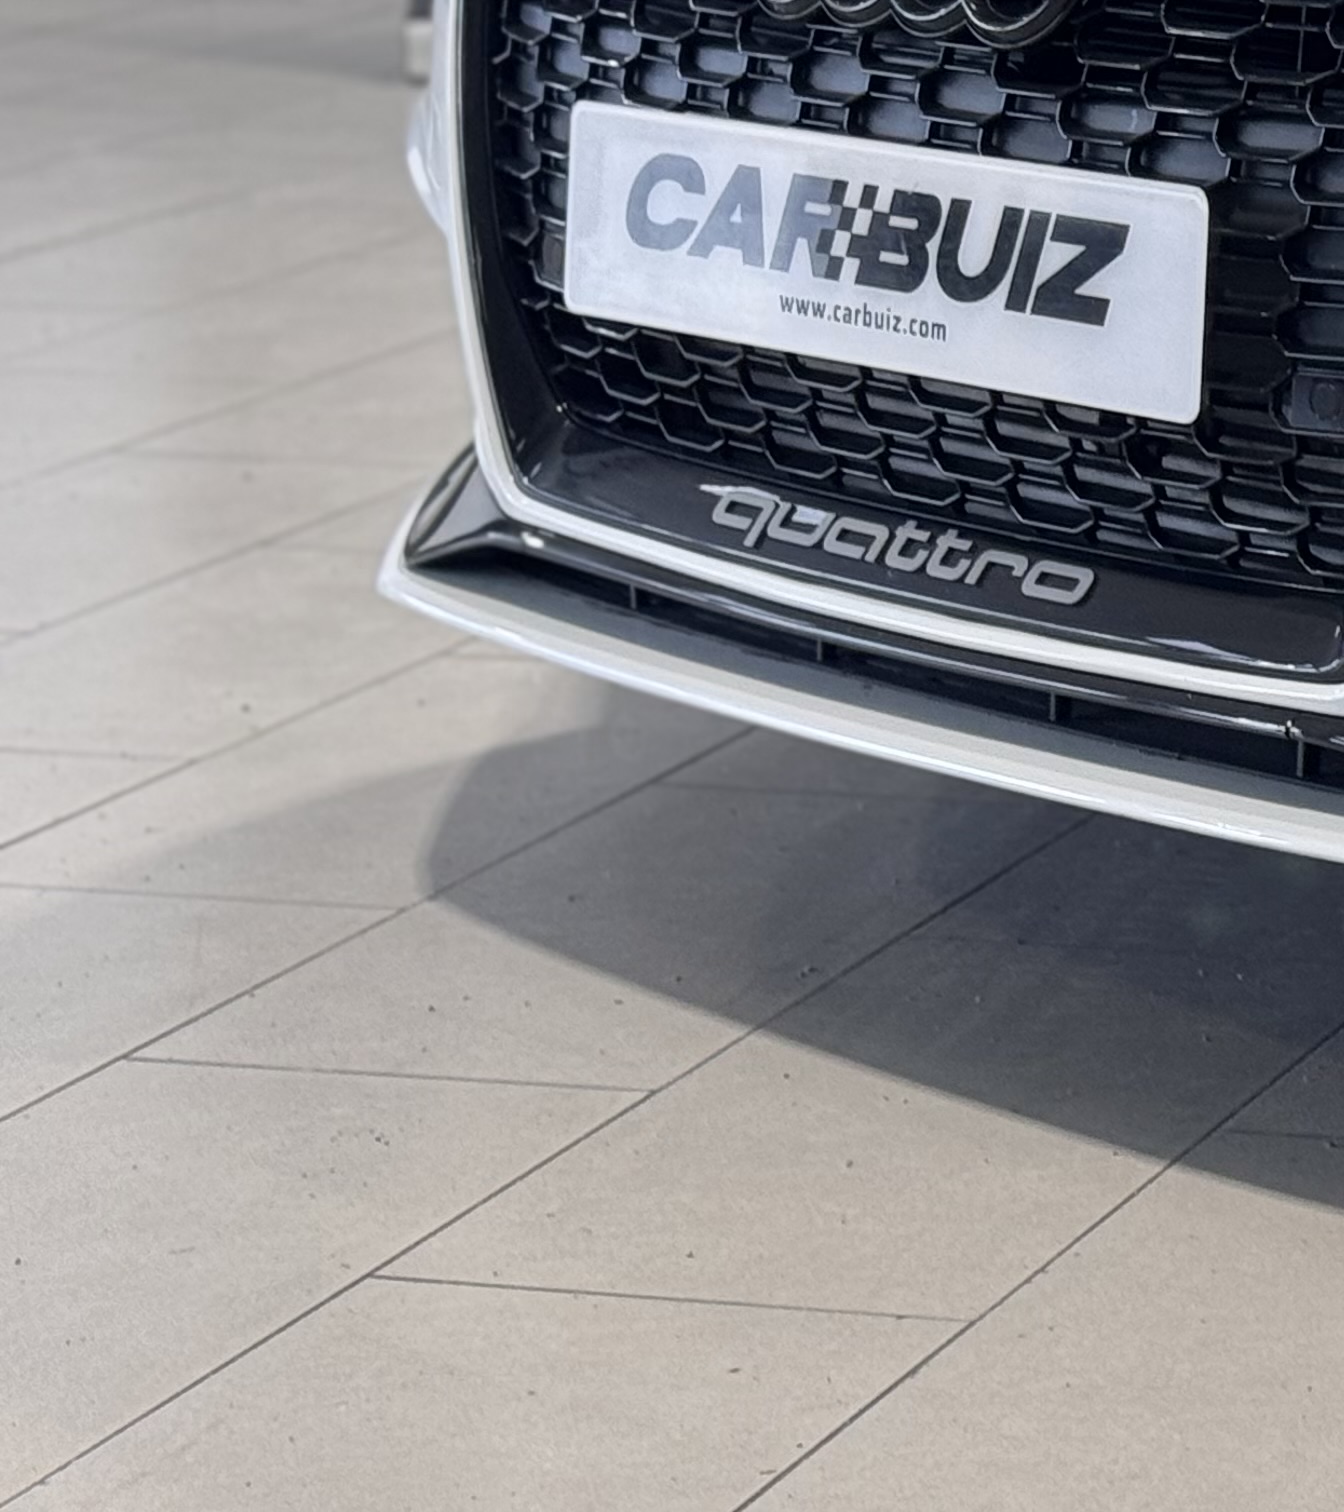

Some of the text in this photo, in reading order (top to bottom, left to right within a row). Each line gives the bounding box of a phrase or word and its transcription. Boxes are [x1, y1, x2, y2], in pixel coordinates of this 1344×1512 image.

[624, 152, 1132, 328] CARBUIZ
[778, 293, 949, 343] www.carbuiz.com
[709, 487, 1096, 606] quattro
